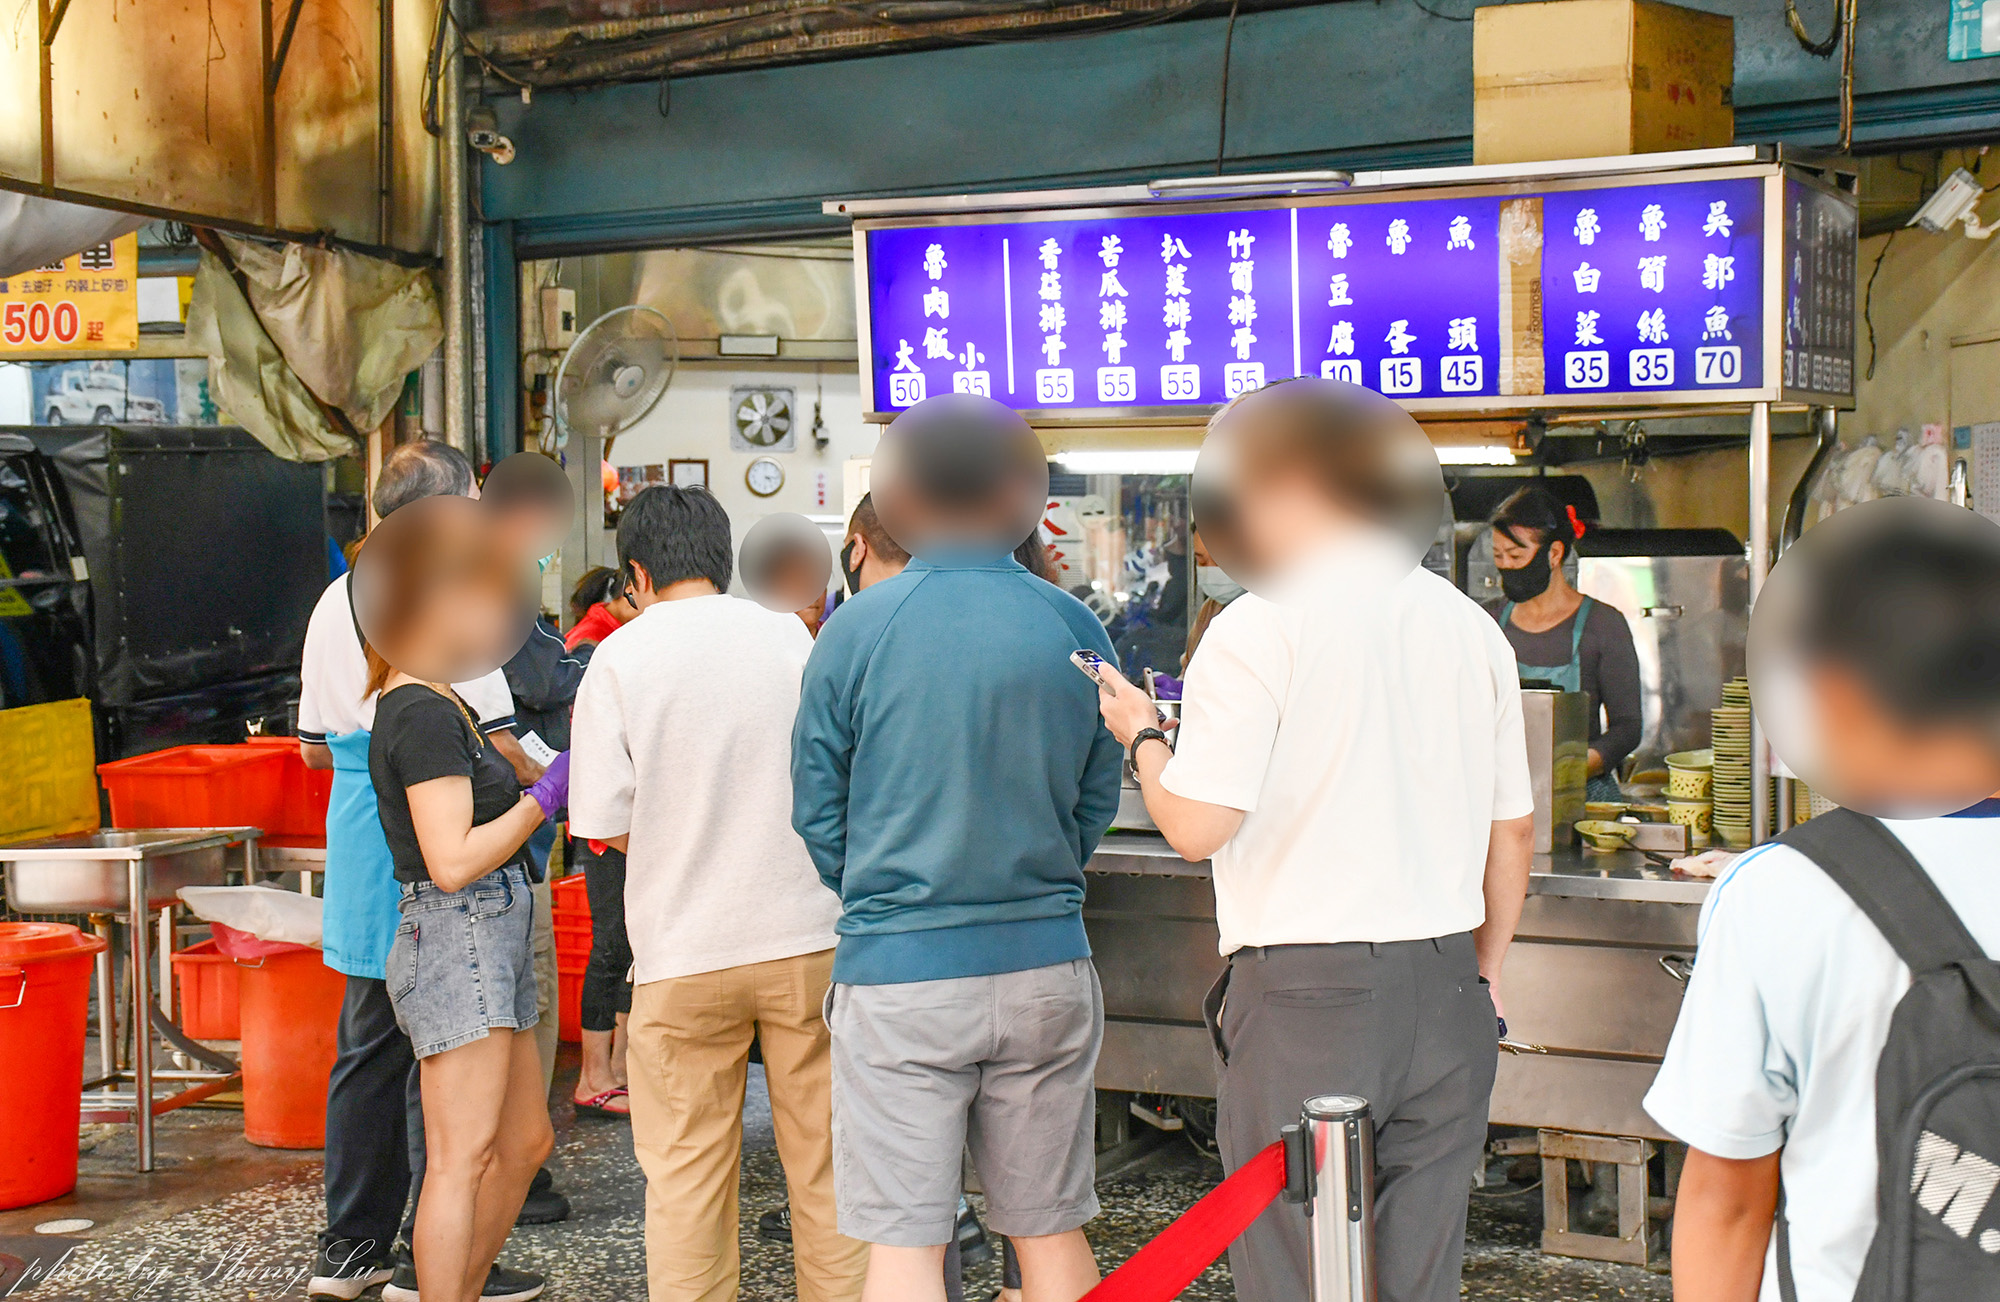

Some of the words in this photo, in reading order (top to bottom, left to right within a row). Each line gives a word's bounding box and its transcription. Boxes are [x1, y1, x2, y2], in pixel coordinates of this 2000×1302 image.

[1385, 219, 1417, 354] 魯蛋
[1447, 216, 1478, 351] 魚頭
[1573, 209, 1604, 346] 魯白菜
[1637, 204, 1669, 344] 魯筍絲
[1702, 200, 1735, 341] 吳郭魚
[922, 244, 955, 360] 魯肉飯
[1098, 235, 1128, 364] 苦瓜排骨
[1161, 234, 1192, 362] 扒菜排骨
[1228, 229, 1257, 360] 竹筍排骨
[1327, 223, 1356, 355] 魯豆腐
[4, 301, 79, 344] 500
[894, 339, 921, 373] 大
[959, 342, 985, 371] 小
[1572, 357, 1603, 383] 35
[1637, 355, 1668, 381] 35
[1702, 351, 1735, 378] 70
[896, 378, 920, 401] 50
[1043, 376, 1067, 398] 55
[1105, 374, 1129, 396] 55
[1168, 372, 1193, 395] 55
[1232, 370, 1257, 393] 55
[1388, 362, 1413, 387] 15
[1447, 361, 1477, 386] 45
